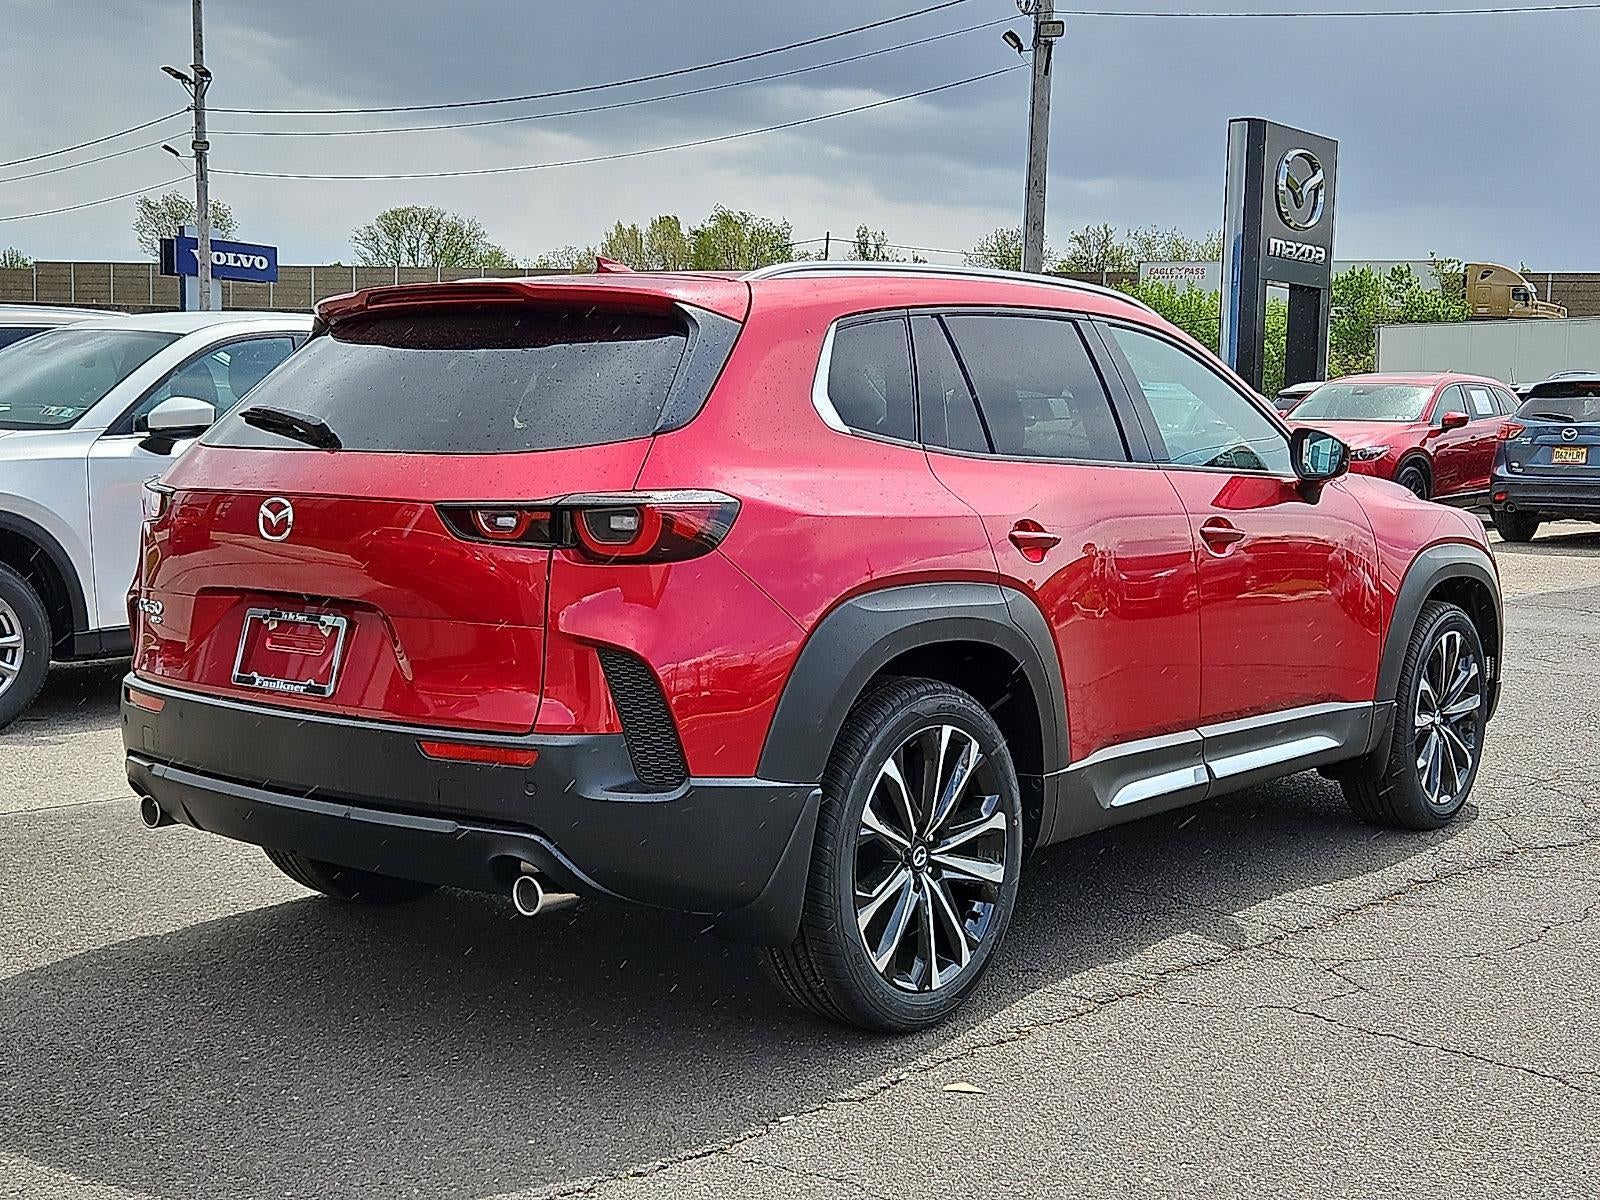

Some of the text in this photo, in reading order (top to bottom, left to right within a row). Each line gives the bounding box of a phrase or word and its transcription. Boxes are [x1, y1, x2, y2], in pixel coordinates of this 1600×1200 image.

[1149, 267, 1206, 275] EAGLE PASS
[254, 677, 307, 693] Faulkner
